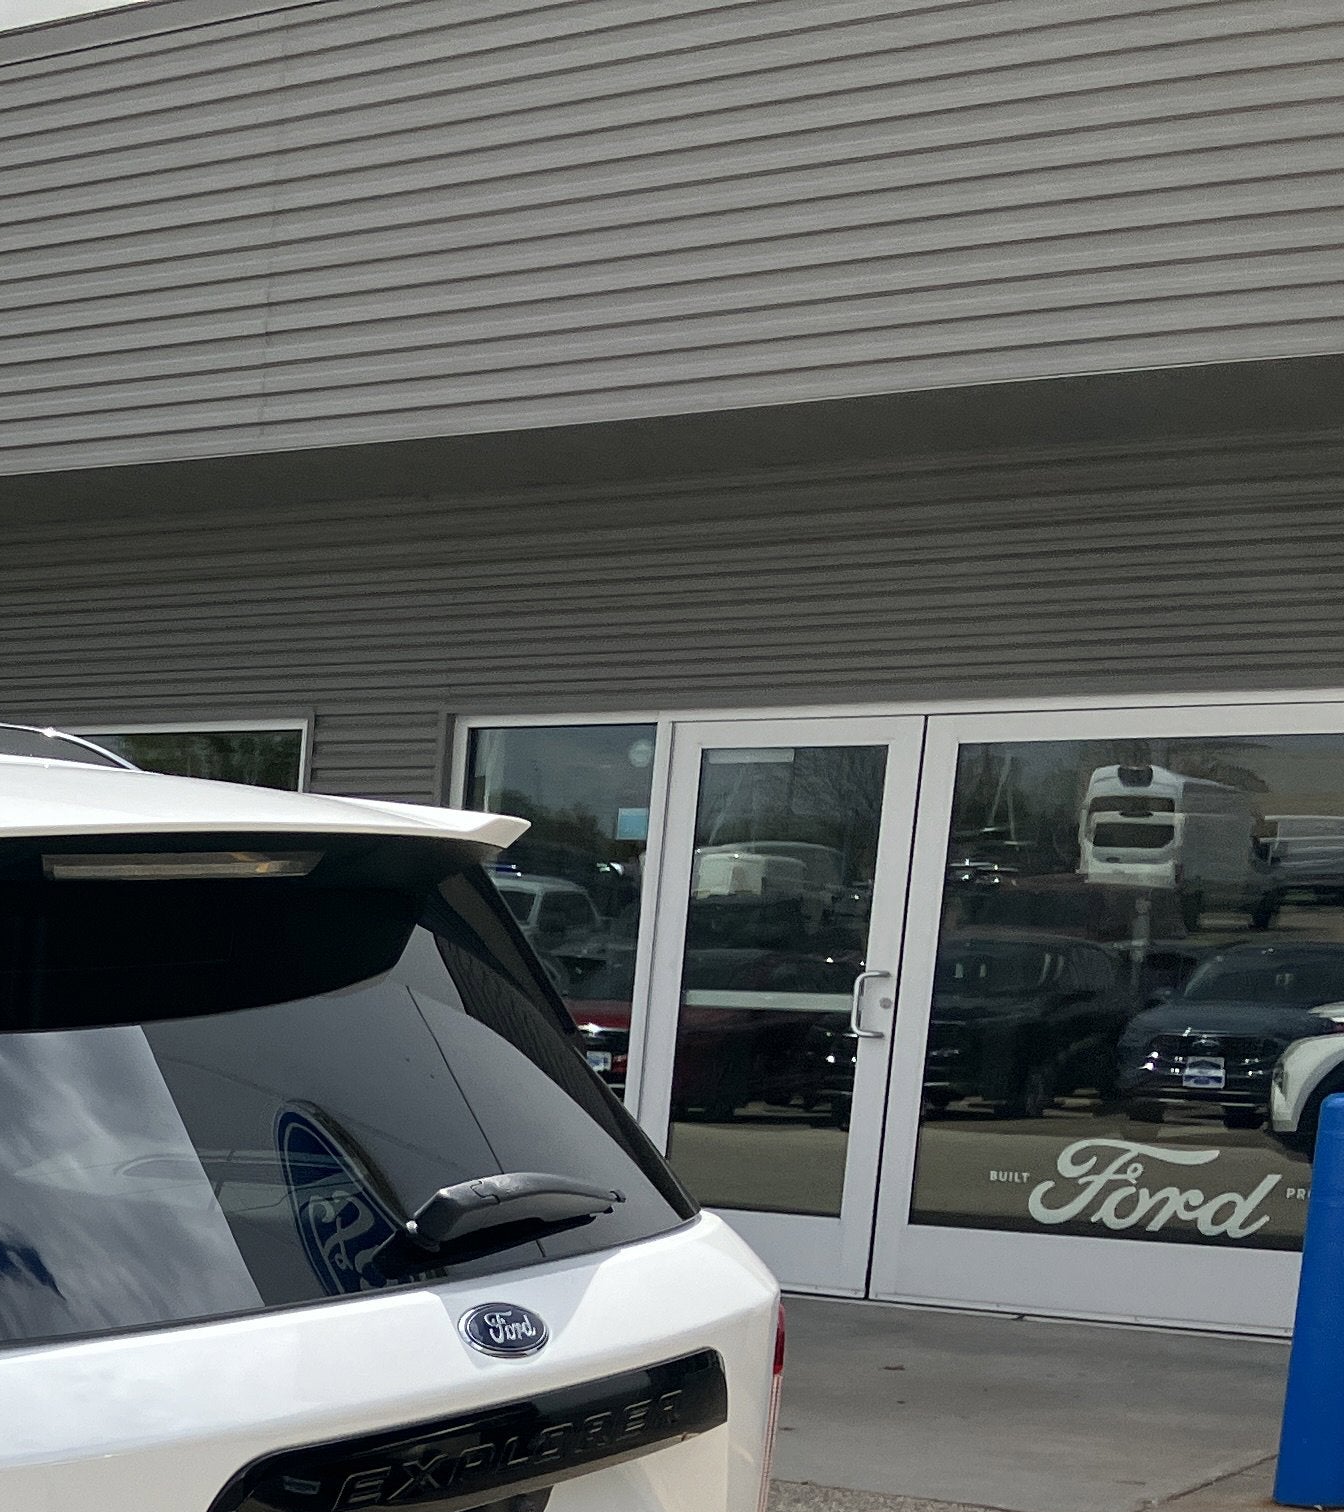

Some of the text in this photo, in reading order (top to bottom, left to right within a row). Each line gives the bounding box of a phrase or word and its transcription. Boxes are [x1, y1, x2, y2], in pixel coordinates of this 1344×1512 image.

[989, 1138, 1311, 1239] BUILT Ford PR
[483, 1310, 537, 1344] Ford
[331, 1389, 682, 1512] EXPLORER
